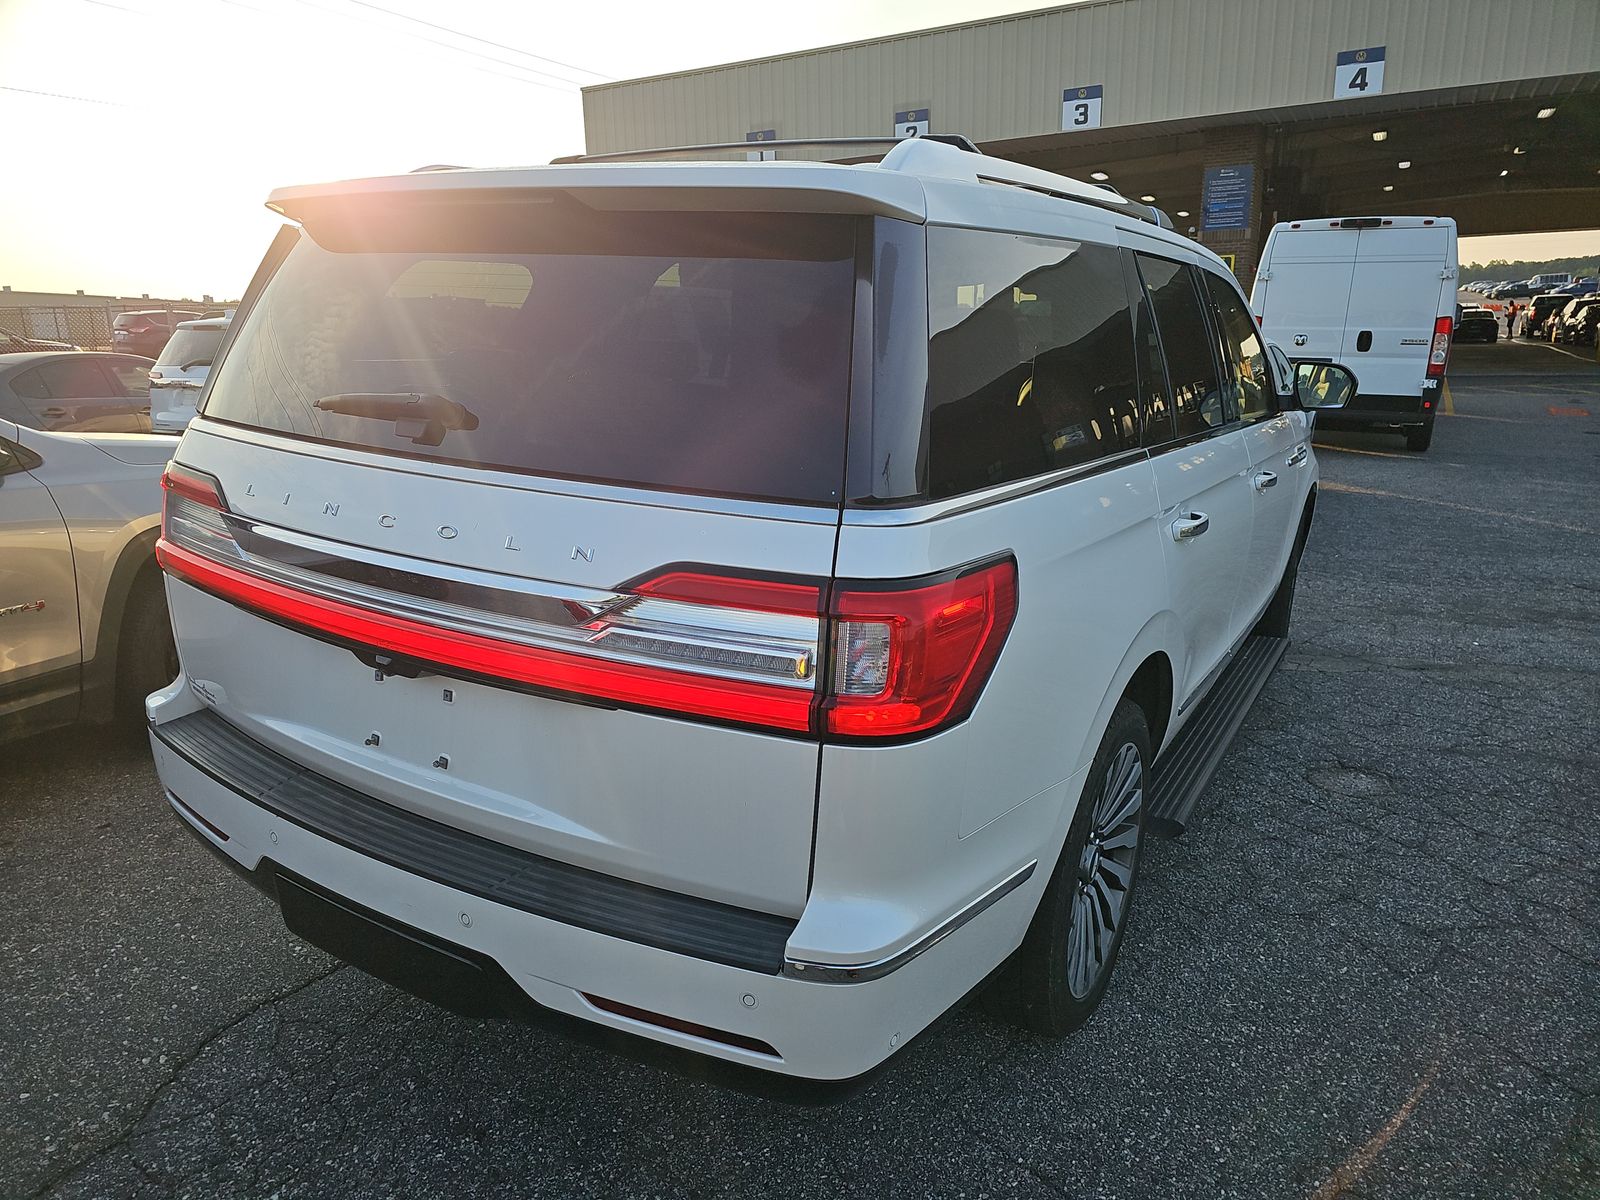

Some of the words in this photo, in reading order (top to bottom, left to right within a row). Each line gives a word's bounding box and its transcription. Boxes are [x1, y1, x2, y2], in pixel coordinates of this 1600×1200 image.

[1348, 67, 1368, 91] 4
[1074, 103, 1088, 125] 3
[245, 483, 595, 563] LINCOLN
